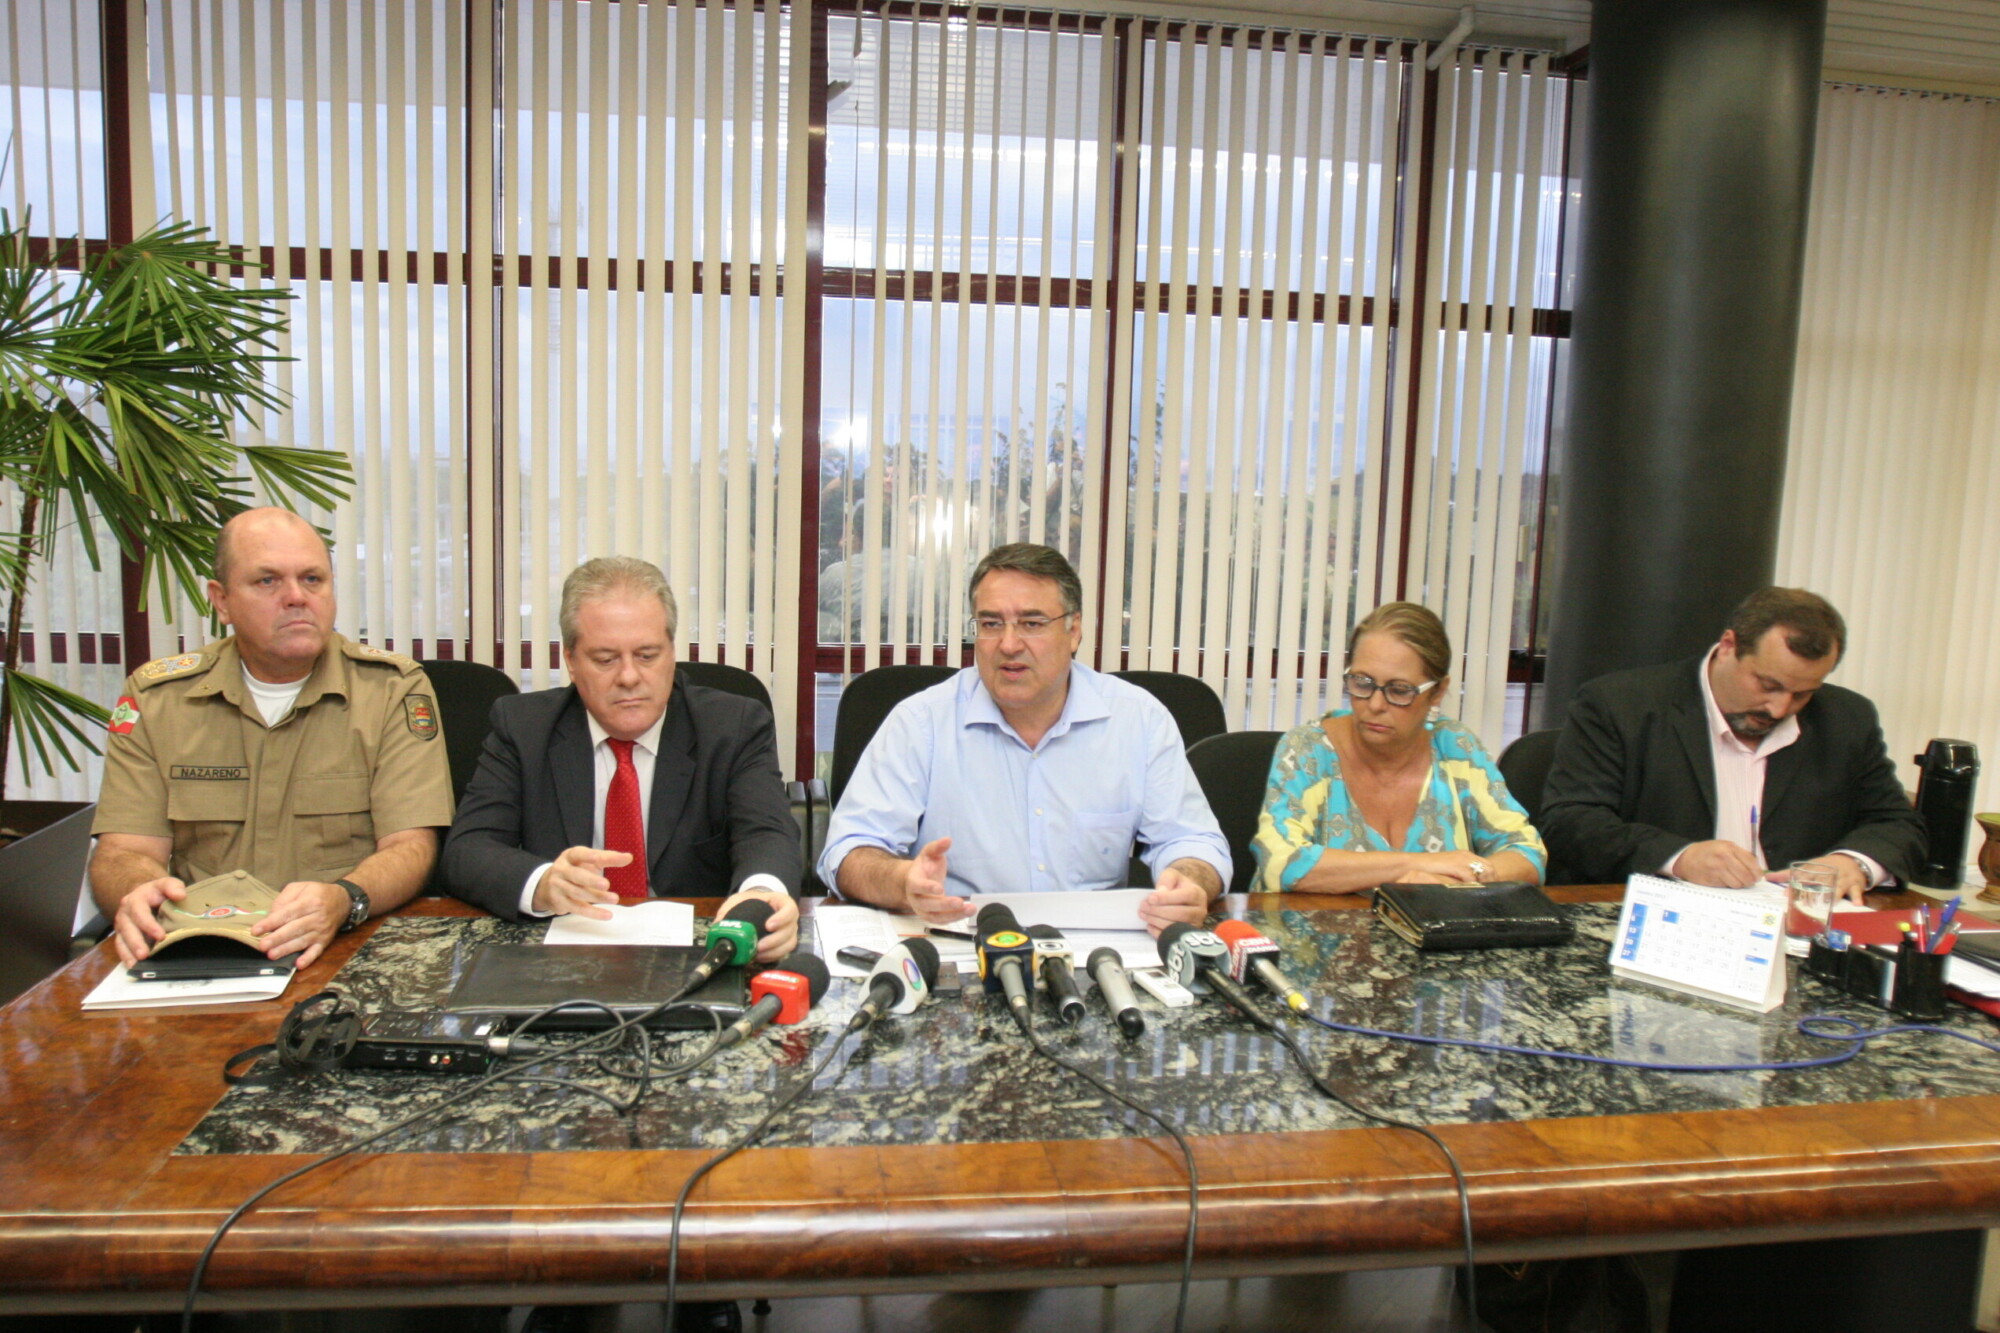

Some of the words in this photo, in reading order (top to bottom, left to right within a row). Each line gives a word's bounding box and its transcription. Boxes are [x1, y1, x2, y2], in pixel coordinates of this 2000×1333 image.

[181, 768, 241, 778] NAZARENO
[1184, 931, 1224, 946] sbt
[1237, 937, 1272, 947] CBN
